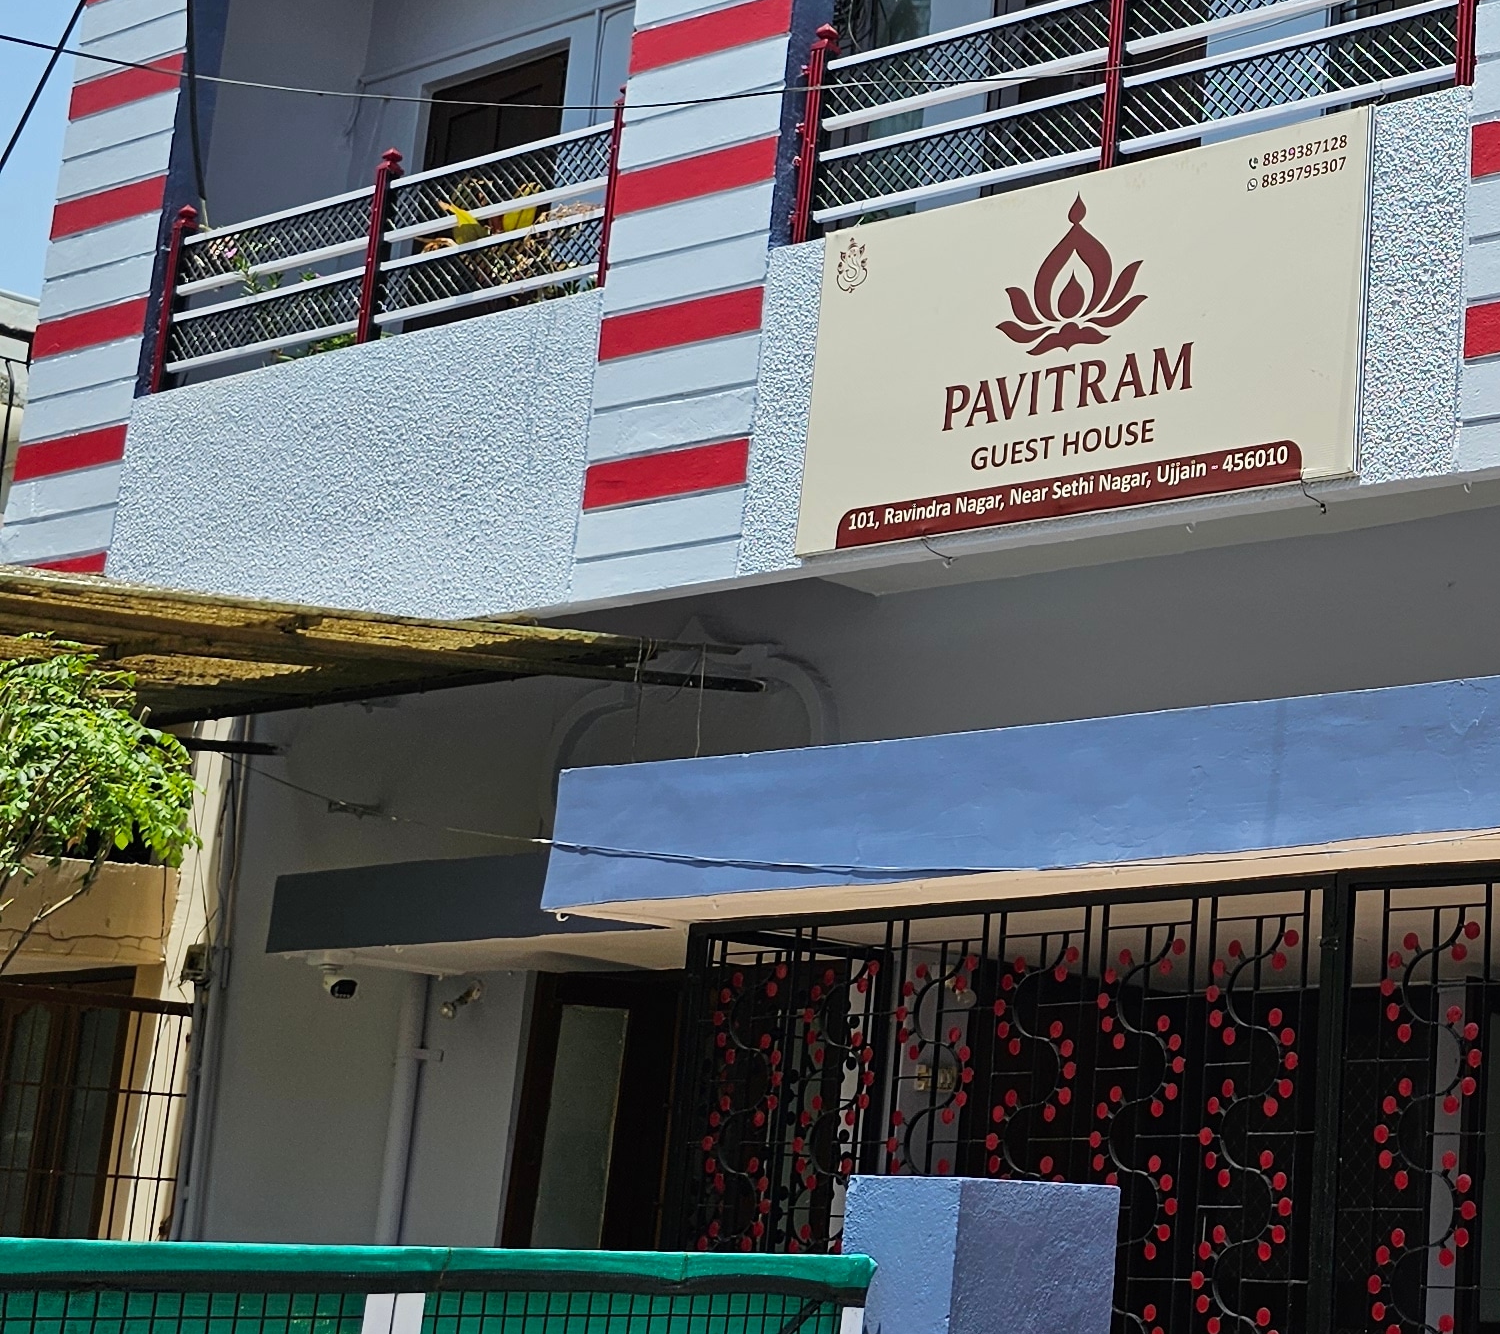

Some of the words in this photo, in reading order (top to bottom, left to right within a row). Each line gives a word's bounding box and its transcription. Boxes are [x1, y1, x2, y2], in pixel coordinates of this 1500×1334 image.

[1261, 156, 1347, 188] 8839795307
[1263, 134, 1348, 167] 8839387128
[942, 341, 1194, 431] PAVITRAM
[971, 435, 1055, 470] GUEST
[1062, 419, 1155, 456] HOUSE
[848, 510, 880, 530] 101,
[884, 499, 951, 525] Ravindra
[955, 492, 1005, 514] Nagar,
[1009, 487, 1049, 506] Near
[1051, 474, 1094, 499] Sethi
[1098, 471, 1152, 493] Nagar,
[1156, 459, 1207, 485] Ujjain
[1222, 445, 1288, 472] 456010
